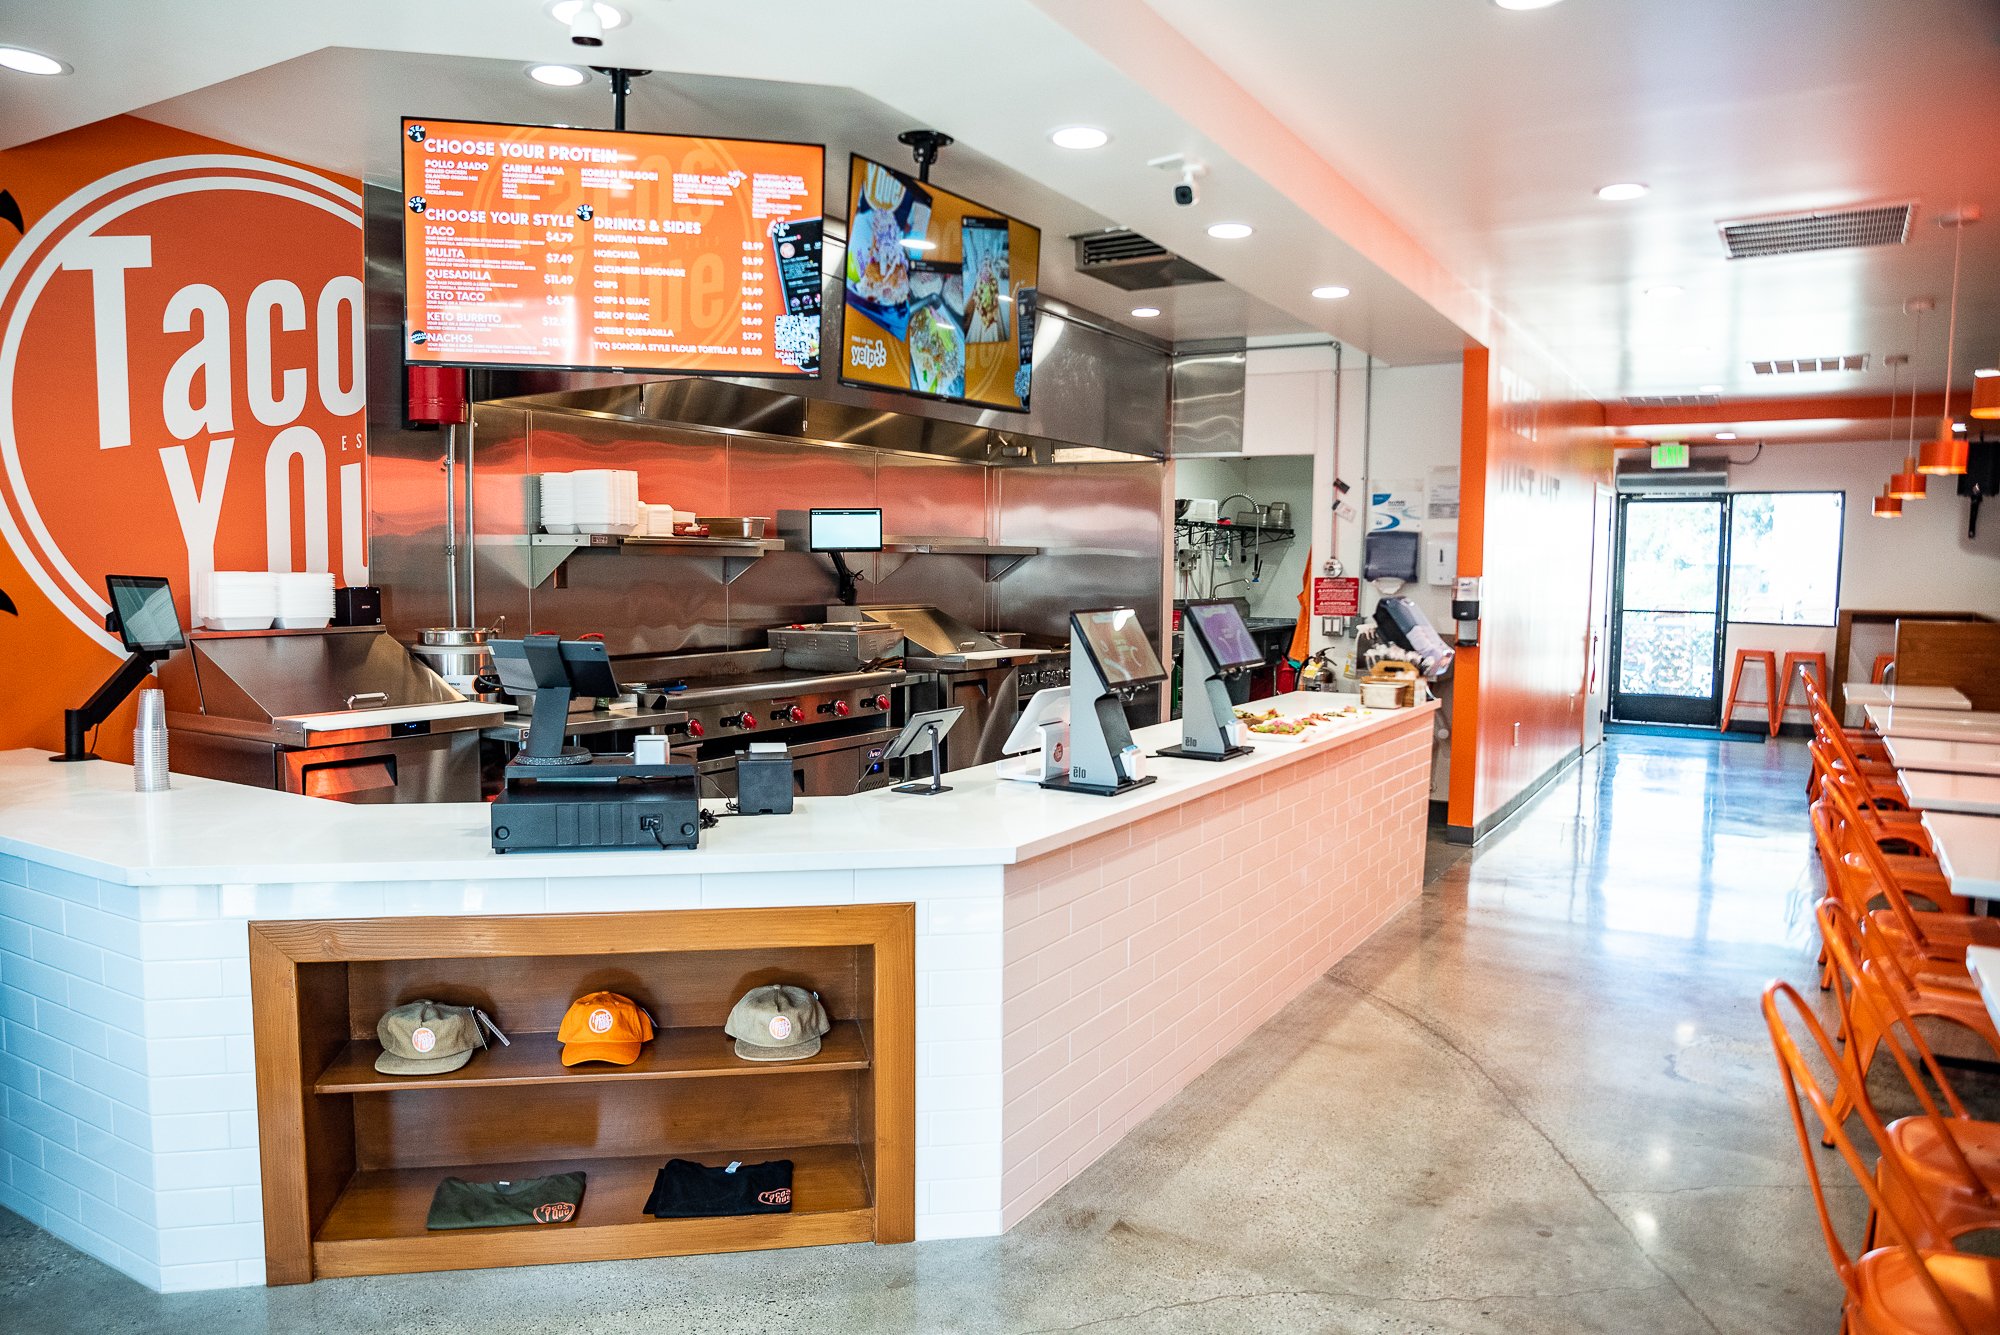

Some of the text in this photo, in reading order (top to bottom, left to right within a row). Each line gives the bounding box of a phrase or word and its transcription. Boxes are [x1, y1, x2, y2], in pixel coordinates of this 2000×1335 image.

[424, 138, 618, 163] CHOOSE YOUR PROTEIN
[425, 159, 489, 171] POLLO ASADO
[534, 166, 564, 176] ASADA
[673, 174, 699, 184] STEAK
[425, 209, 574, 228] CHOOSE YOUR STYLE
[594, 217, 702, 234] DRINKS & SIDES
[425, 226, 455, 236] TACO
[545, 232, 574, 243] $4.79
[594, 234, 637, 244] FOUNTAIN
[637, 236, 668, 245] DRINKS
[425, 247, 465, 258] MULITA
[546, 253, 574, 264] $7.49
[594, 249, 640, 260] HORCHATA
[594, 264, 640, 275] CUCUMBER
[640, 267, 686, 277] LEMONADE
[425, 269, 574, 285] QUESADILLA $11.49
[594, 280, 618, 289] CHIPS
[426, 290, 454, 300] KETO
[456, 292, 485, 302] TACO
[594, 295, 618, 305] CHIPS
[626, 296, 650, 306] GUAC
[427, 311, 454, 321] KETO
[456, 313, 502, 323] BURRITO
[594, 311, 612, 320] SIDE
[613, 312, 624, 320] OF
[625, 312, 650, 321] GUAC
[427, 332, 473, 343] NACHOS
[594, 326, 624, 336] CHEESE
[625, 327, 674, 337] QUESADILLA
[594, 342, 610, 351] TYQ
[612, 343, 647, 352] SONORA
[647, 344, 670, 353] STYLE
[671, 345, 697, 353] FLOUR
[698, 346, 738, 355] TORTILLAS
[852, 346, 876, 369] yelp
[1658, 446, 1683, 465] EXIT
